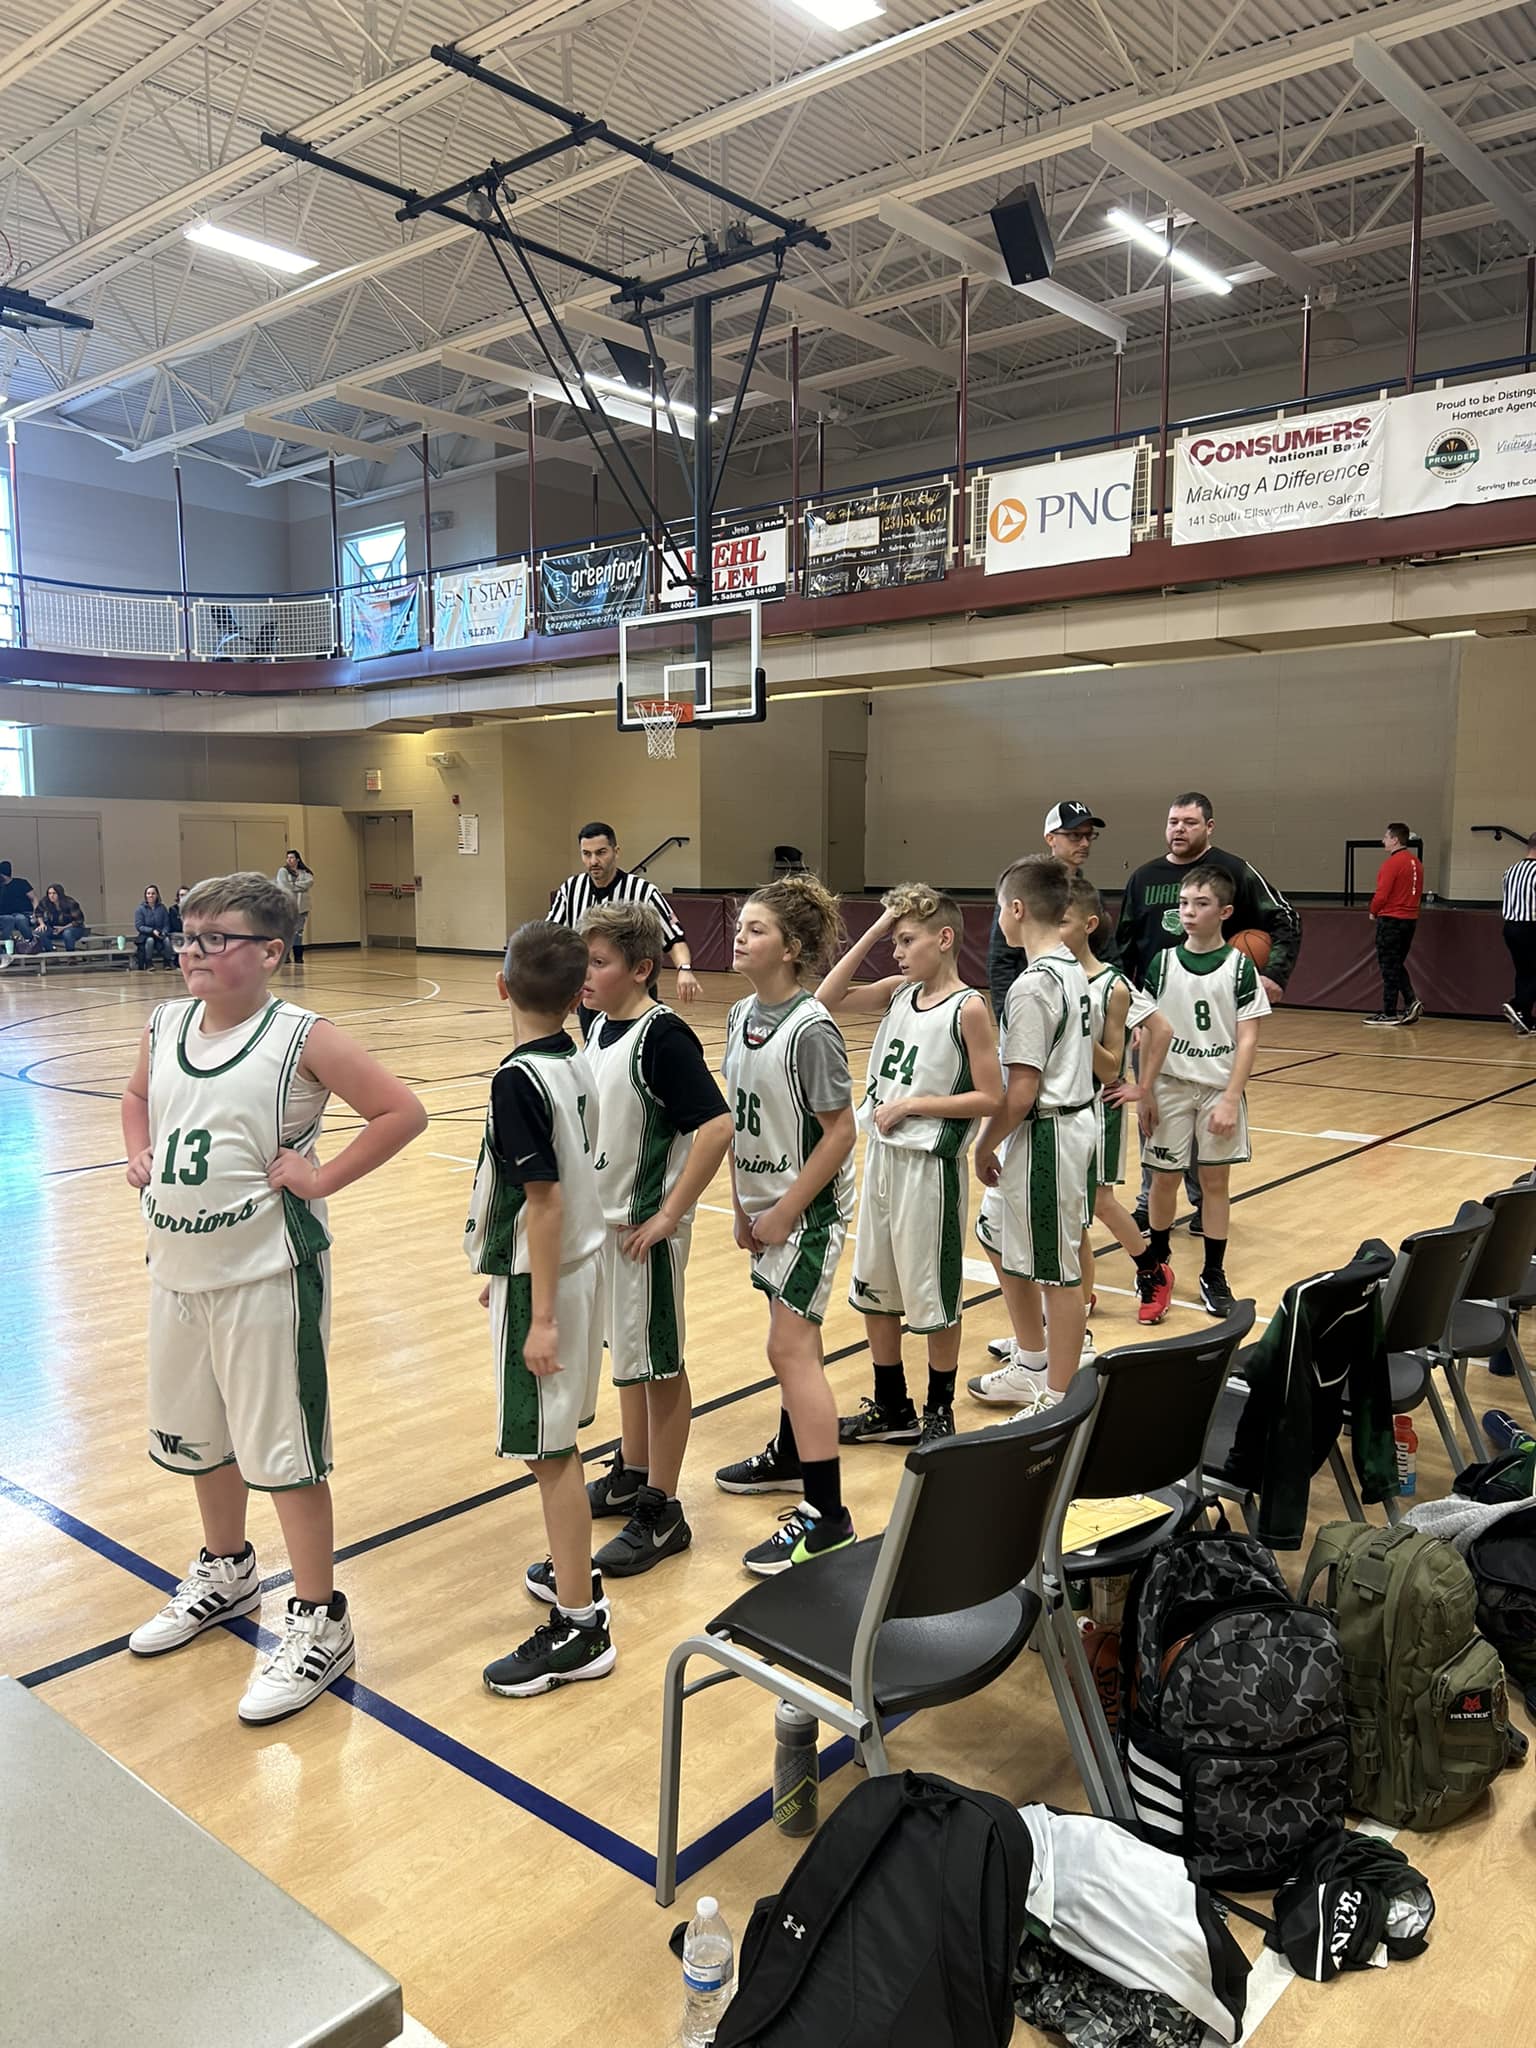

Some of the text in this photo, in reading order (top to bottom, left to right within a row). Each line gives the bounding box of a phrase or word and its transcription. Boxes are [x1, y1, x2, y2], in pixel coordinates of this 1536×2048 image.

[1436, 398, 1466, 411] Proud
[1469, 397, 1480, 406] to
[1483, 395, 1495, 403] be
[1452, 406, 1504, 421] Homecare
[1188, 417, 1372, 466] CONSUMERS
[1269, 446, 1328, 465] National
[1428, 452, 1476, 465] PROVIDER
[1186, 462, 1370, 504] Making A Difference
[1507, 479, 1520, 488] the
[1035, 483, 1131, 533] PNC
[1188, 515, 1205, 527] 141
[731, 525, 750, 536] Jeep
[571, 552, 642, 593] greenford
[480, 577, 523, 603] STATE
[1194, 1000, 1211, 1031] 8
[880, 1038, 919, 1086] 24
[161, 1127, 213, 1186] 13
